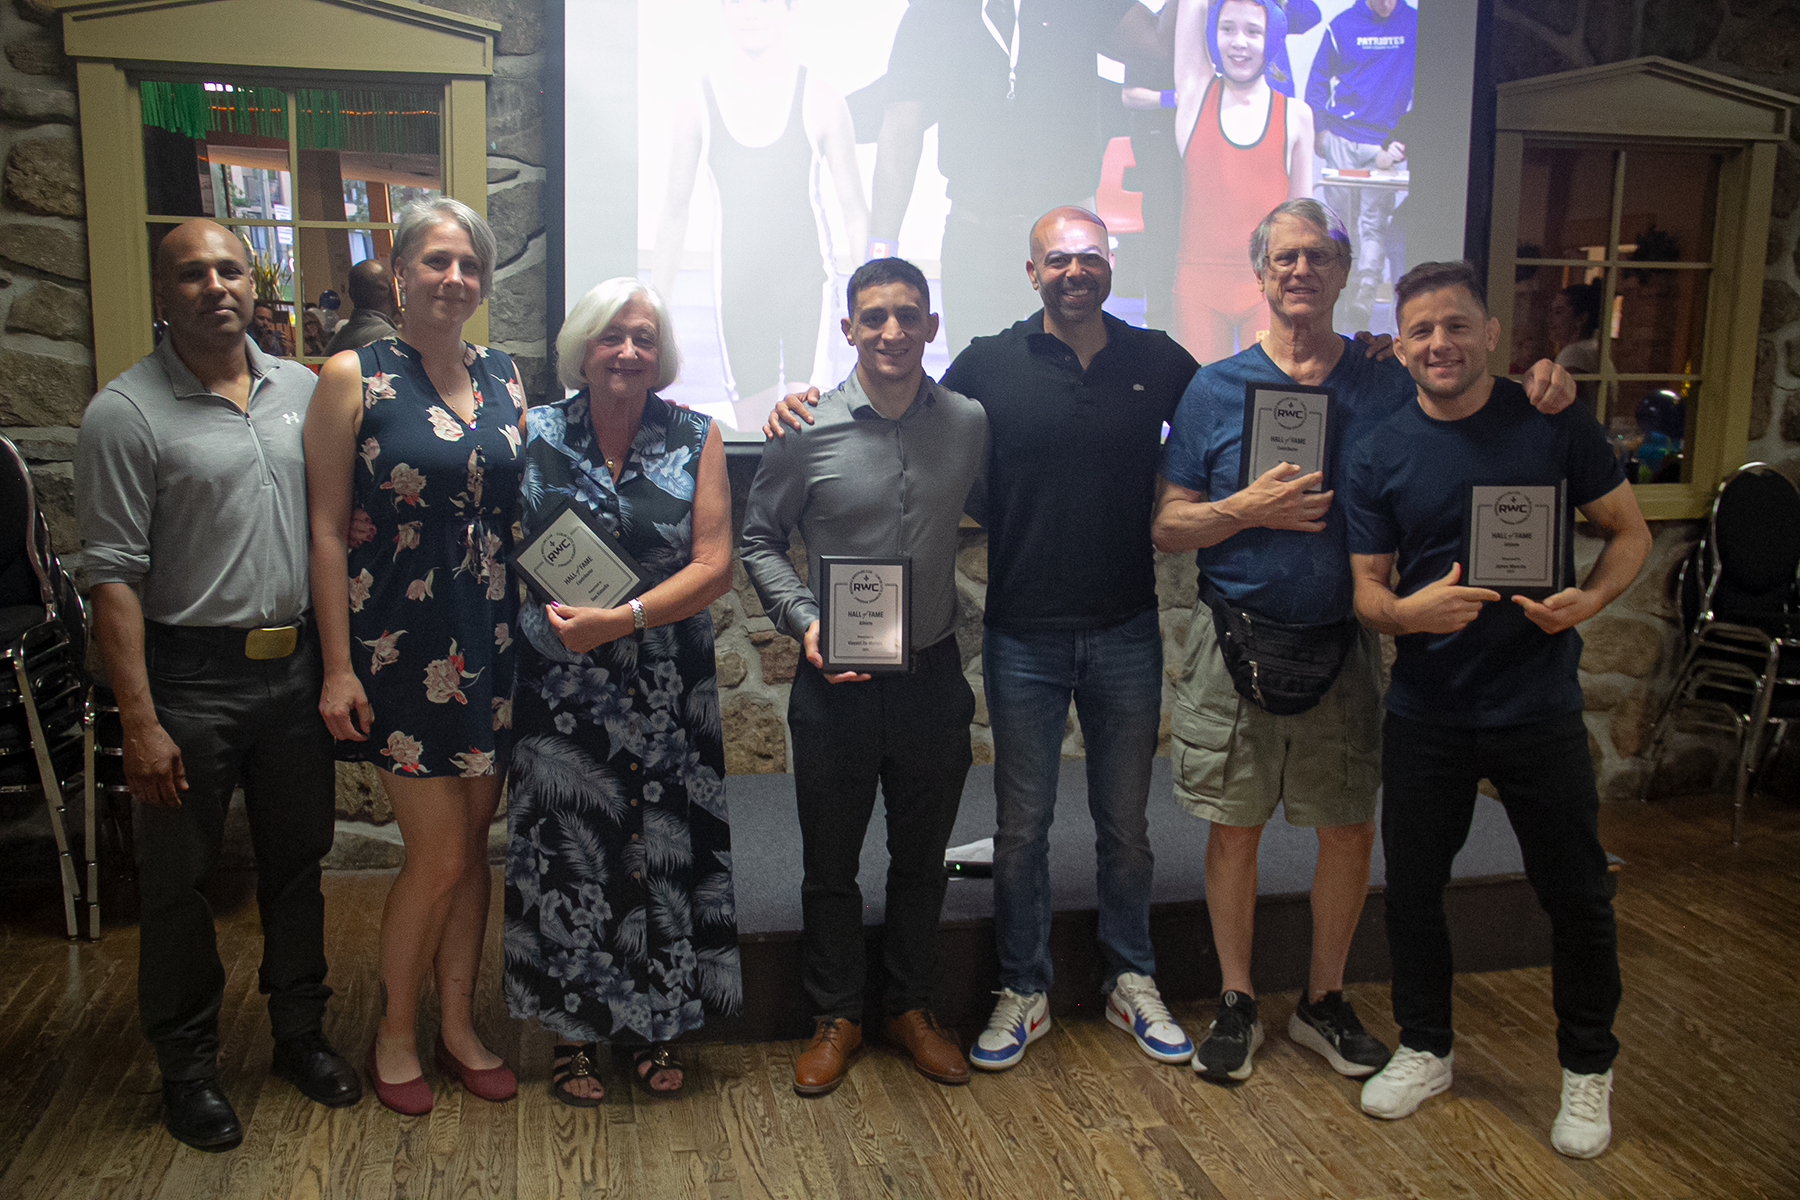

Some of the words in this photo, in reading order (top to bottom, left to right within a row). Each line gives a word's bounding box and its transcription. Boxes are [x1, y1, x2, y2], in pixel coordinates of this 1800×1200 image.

[1277, 409, 1303, 419] RWC
[1270, 436, 1284, 444] HALL
[1499, 504, 1528, 513] RWC
[547, 539, 571, 562] RWC
[563, 572, 577, 585] HALL
[579, 556, 594, 570] FAME
[853, 583, 880, 592] RWC
